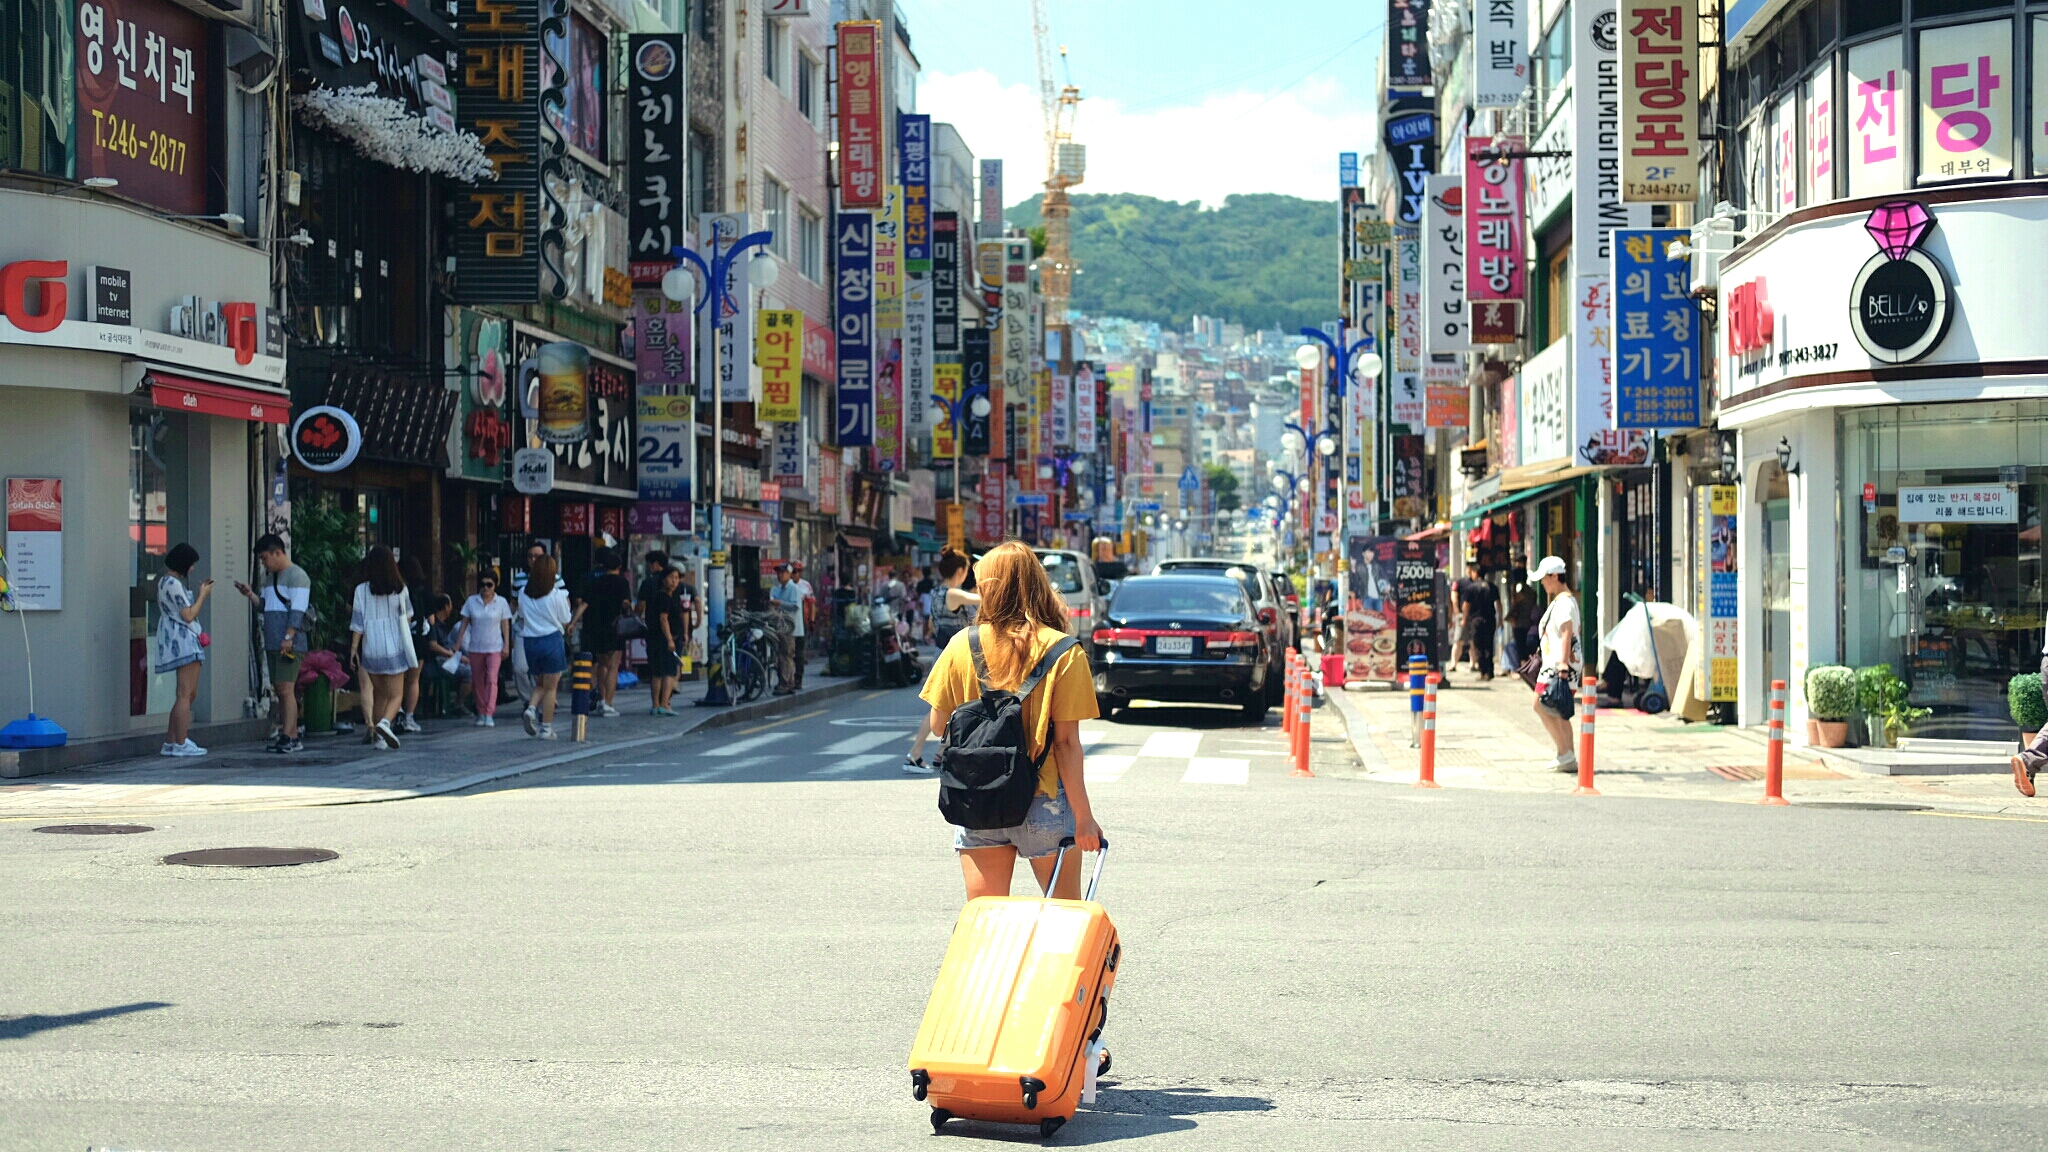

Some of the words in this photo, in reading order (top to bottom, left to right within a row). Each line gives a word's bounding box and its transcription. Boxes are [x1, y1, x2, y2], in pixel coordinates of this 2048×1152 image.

[80, 2, 195, 115] 영신치과
[1629, 6, 1690, 157] 전당포
[92, 109, 186, 176] T.246-2877
[1391, 115, 1432, 139] 아이비
[1645, 166, 1676, 181] 2F
[1941, 157, 1991, 176] 대부업
[1628, 183, 1691, 196] T.244-4747
[905, 185, 928, 245] 부동산
[100, 275, 127, 288] mobile
[875, 241, 897, 296] 갈매기
[98, 305, 130, 319] internet
[109, 291, 119, 302] tv
[840, 222, 872, 437] 신창의료기
[1622, 269, 1654, 381] 의료기
[1660, 272, 1693, 381] 보청기
[662, 345, 684, 378] 소주
[764, 331, 794, 405] 아구찜
[638, 437, 683, 468] 24
[519, 462, 549, 475] Asahi
[1906, 493, 1924, 503] 집에
[1928, 493, 1946, 503] 있는
[1957, 505, 2009, 516] 해드립니다.
